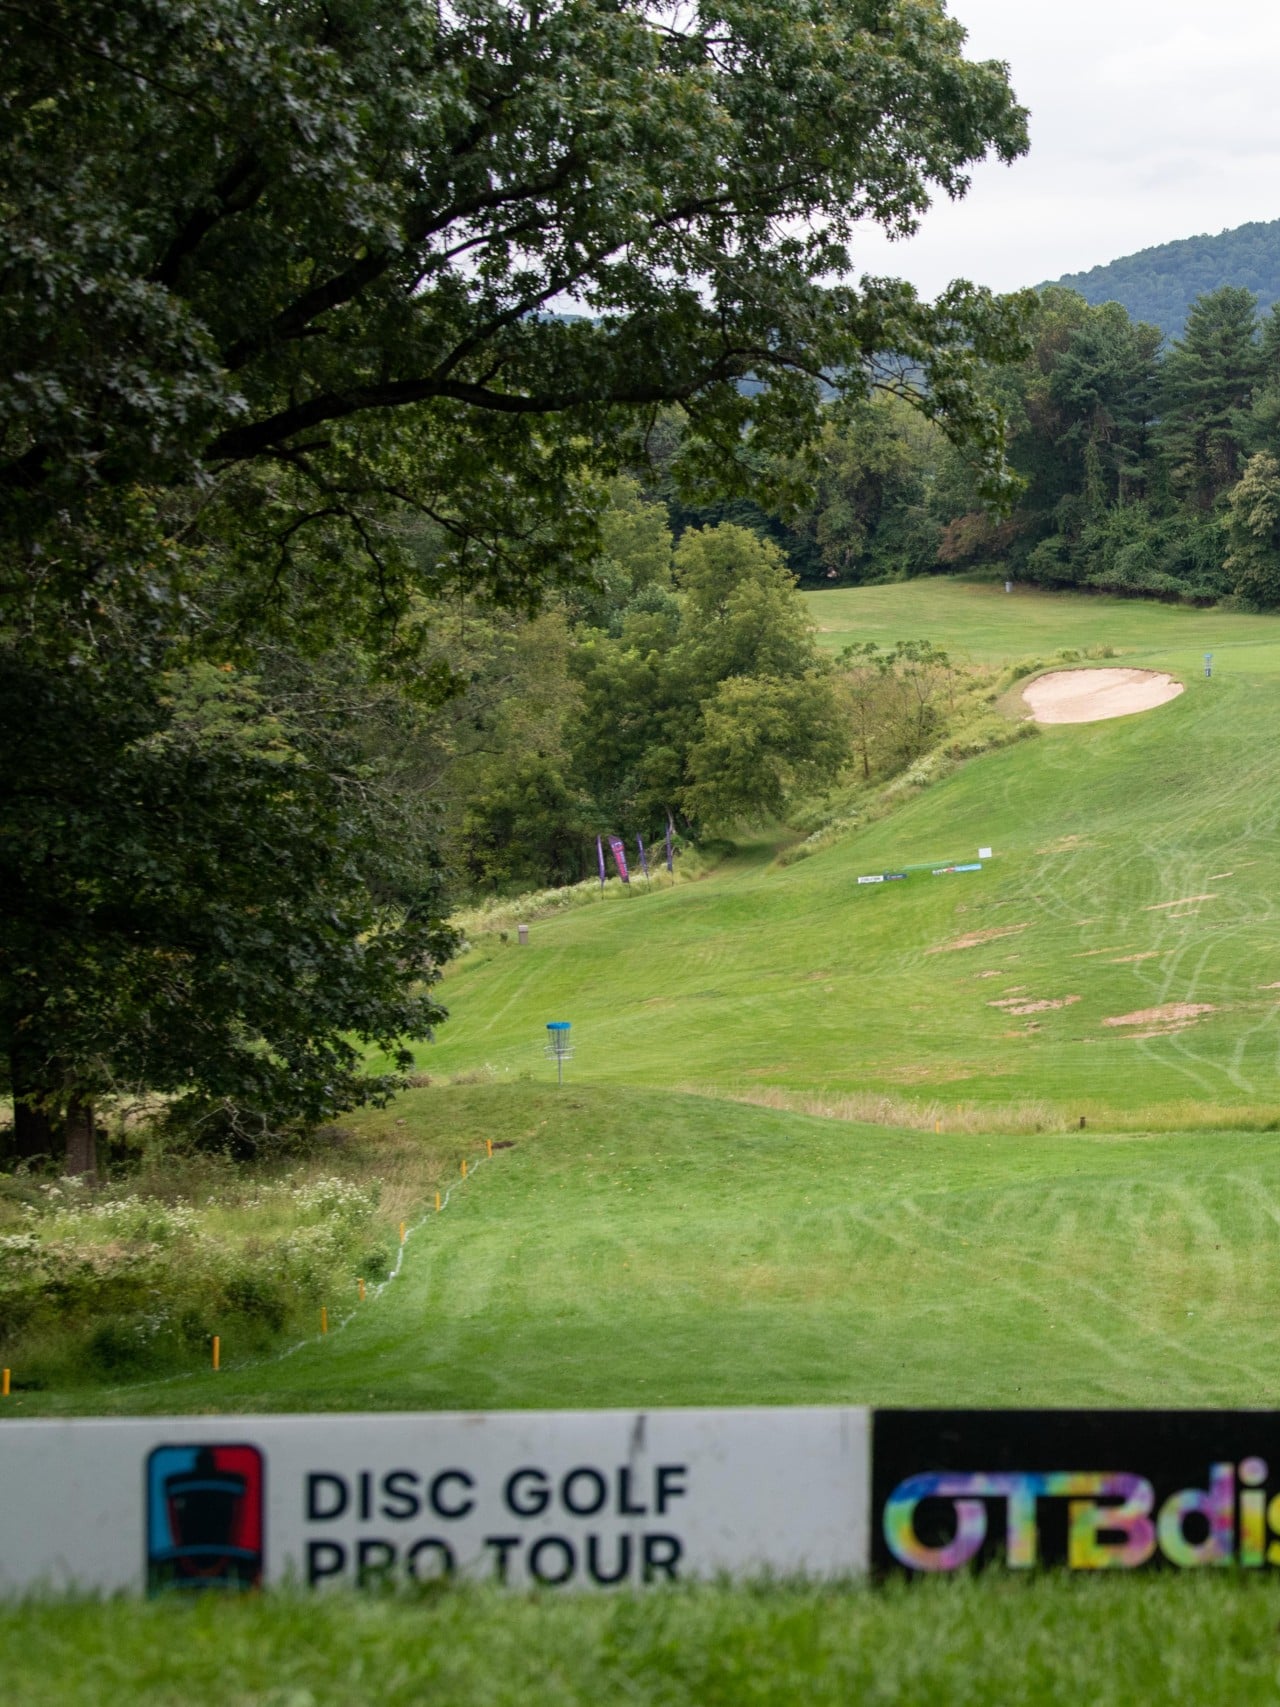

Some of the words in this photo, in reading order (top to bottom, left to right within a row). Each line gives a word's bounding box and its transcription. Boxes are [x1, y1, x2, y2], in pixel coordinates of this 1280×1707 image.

[306, 1469, 476, 1522] DISC
[503, 1466, 688, 1516] GOLF
[306, 1538, 457, 1588] PRO
[484, 1534, 684, 1586] TOUR
